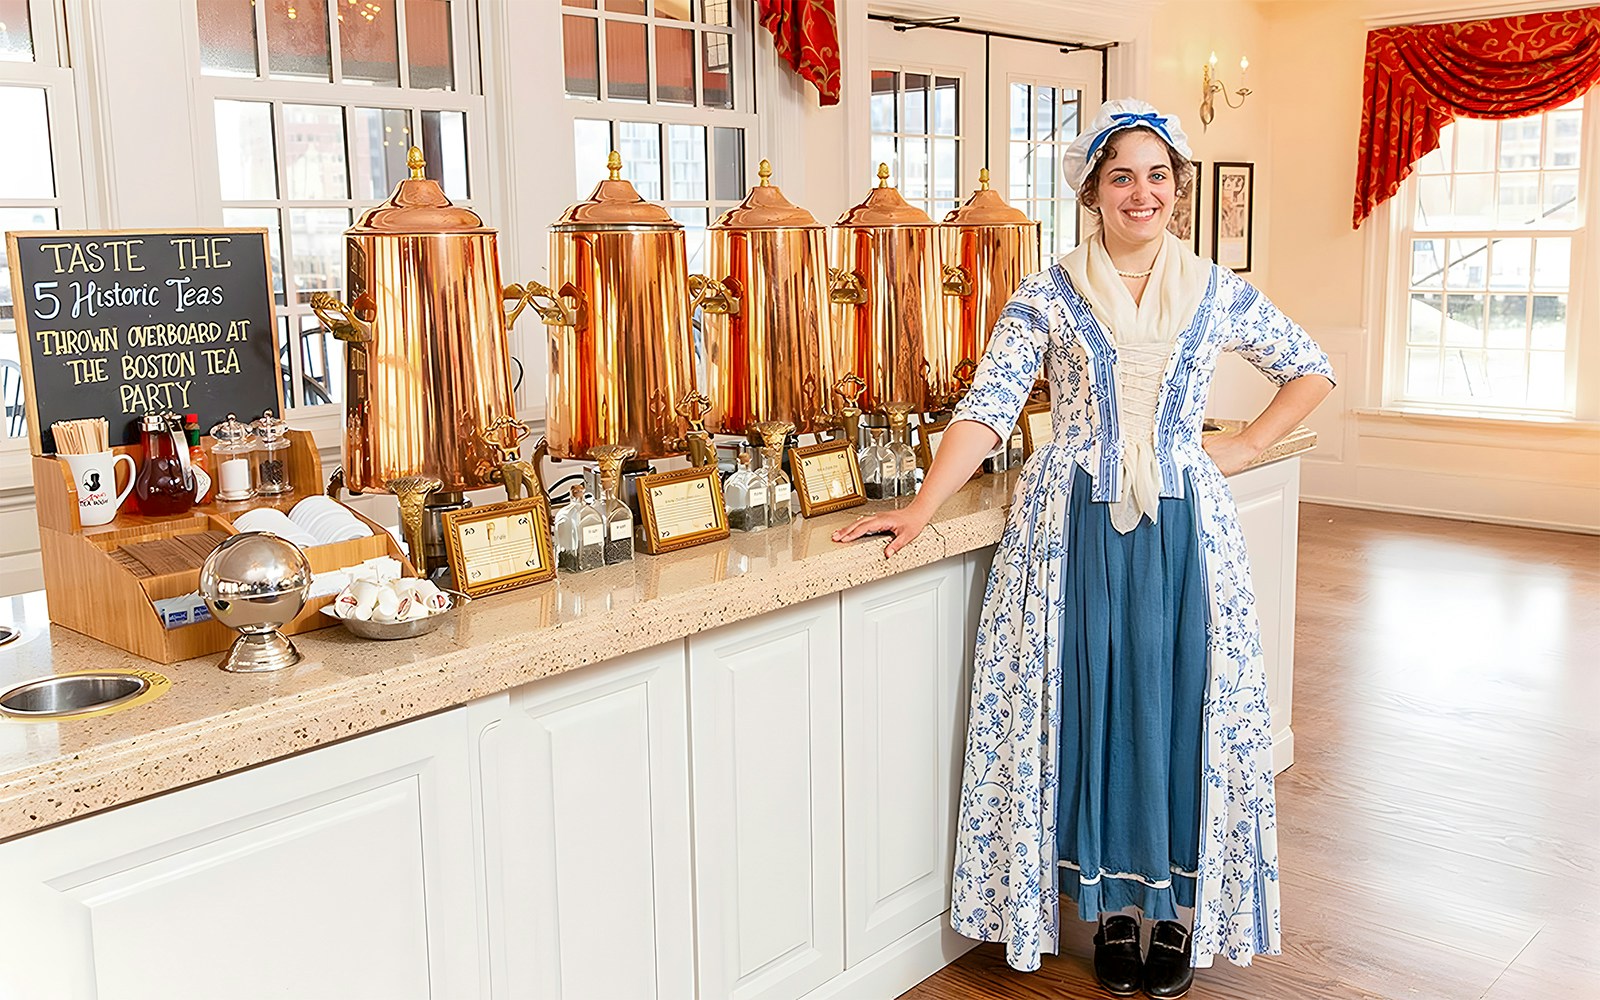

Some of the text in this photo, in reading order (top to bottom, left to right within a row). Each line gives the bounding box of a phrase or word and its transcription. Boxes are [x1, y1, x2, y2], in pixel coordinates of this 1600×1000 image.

[40, 237, 232, 274] TASTE THE
[33, 276, 223, 320] 5 Historic Teas
[36, 319, 251, 356] THROWN OVERBOARD AT
[66, 348, 241, 386] THE BOSTON TEA
[119, 380, 193, 414] PARTY
